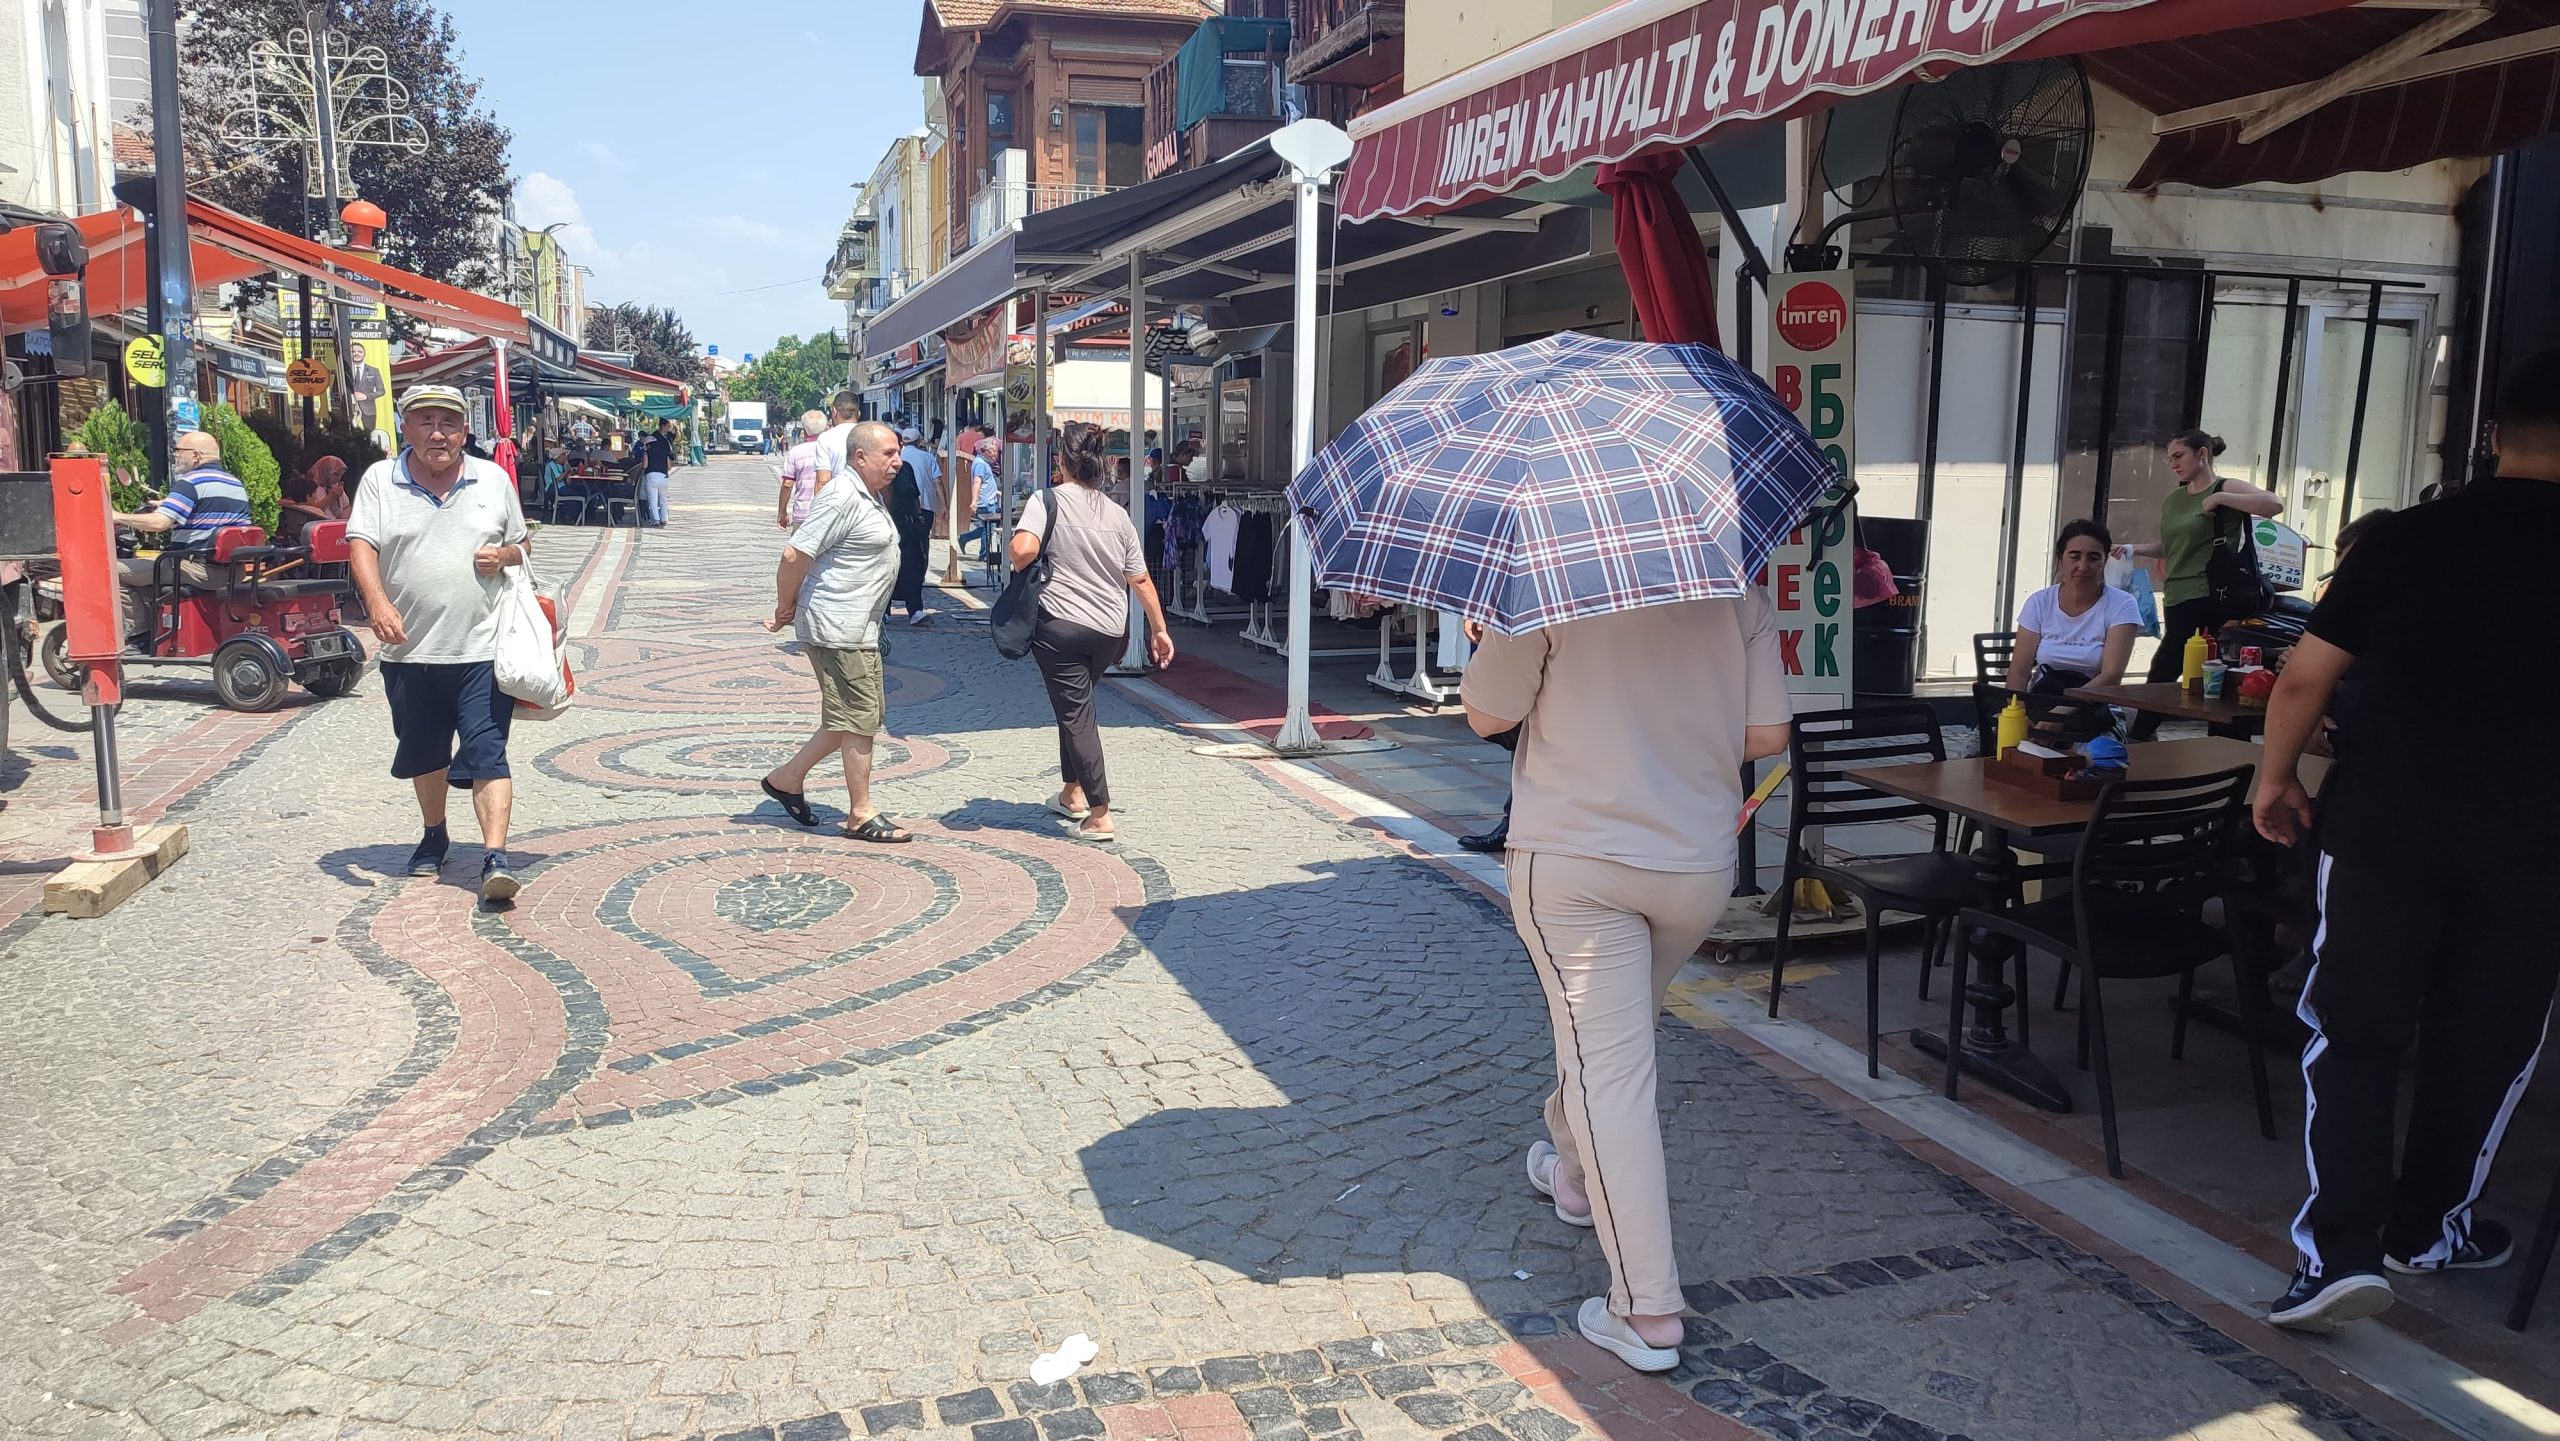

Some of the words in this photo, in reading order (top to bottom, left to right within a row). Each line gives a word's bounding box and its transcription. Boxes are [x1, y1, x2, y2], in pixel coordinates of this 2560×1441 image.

[1438, 99, 1531, 188] İMREN
[1529, 33, 1702, 164] KAHVALTI
[1703, 20, 1737, 111] &
[289, 369, 319, 377] SELF
[244, 625, 269, 634] APEC
